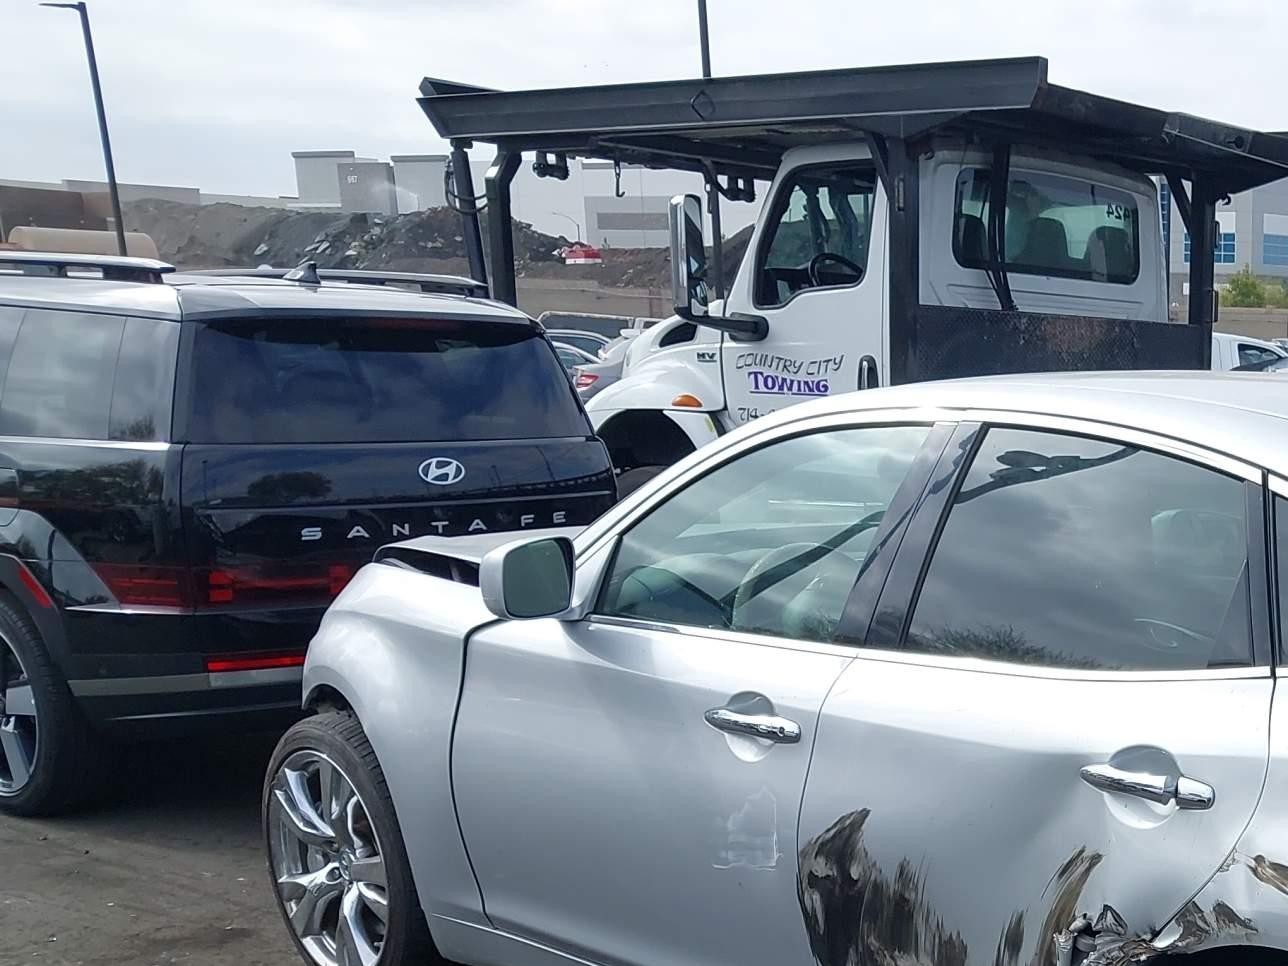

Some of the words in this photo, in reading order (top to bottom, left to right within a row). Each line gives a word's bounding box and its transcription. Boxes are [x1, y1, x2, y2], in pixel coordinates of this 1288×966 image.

[735, 352, 804, 375] COUNTRY
[806, 354, 845, 376] CITY
[747, 371, 830, 394] TOWING
[301, 518, 488, 541] SANTA
[520, 511, 566, 527] FE
